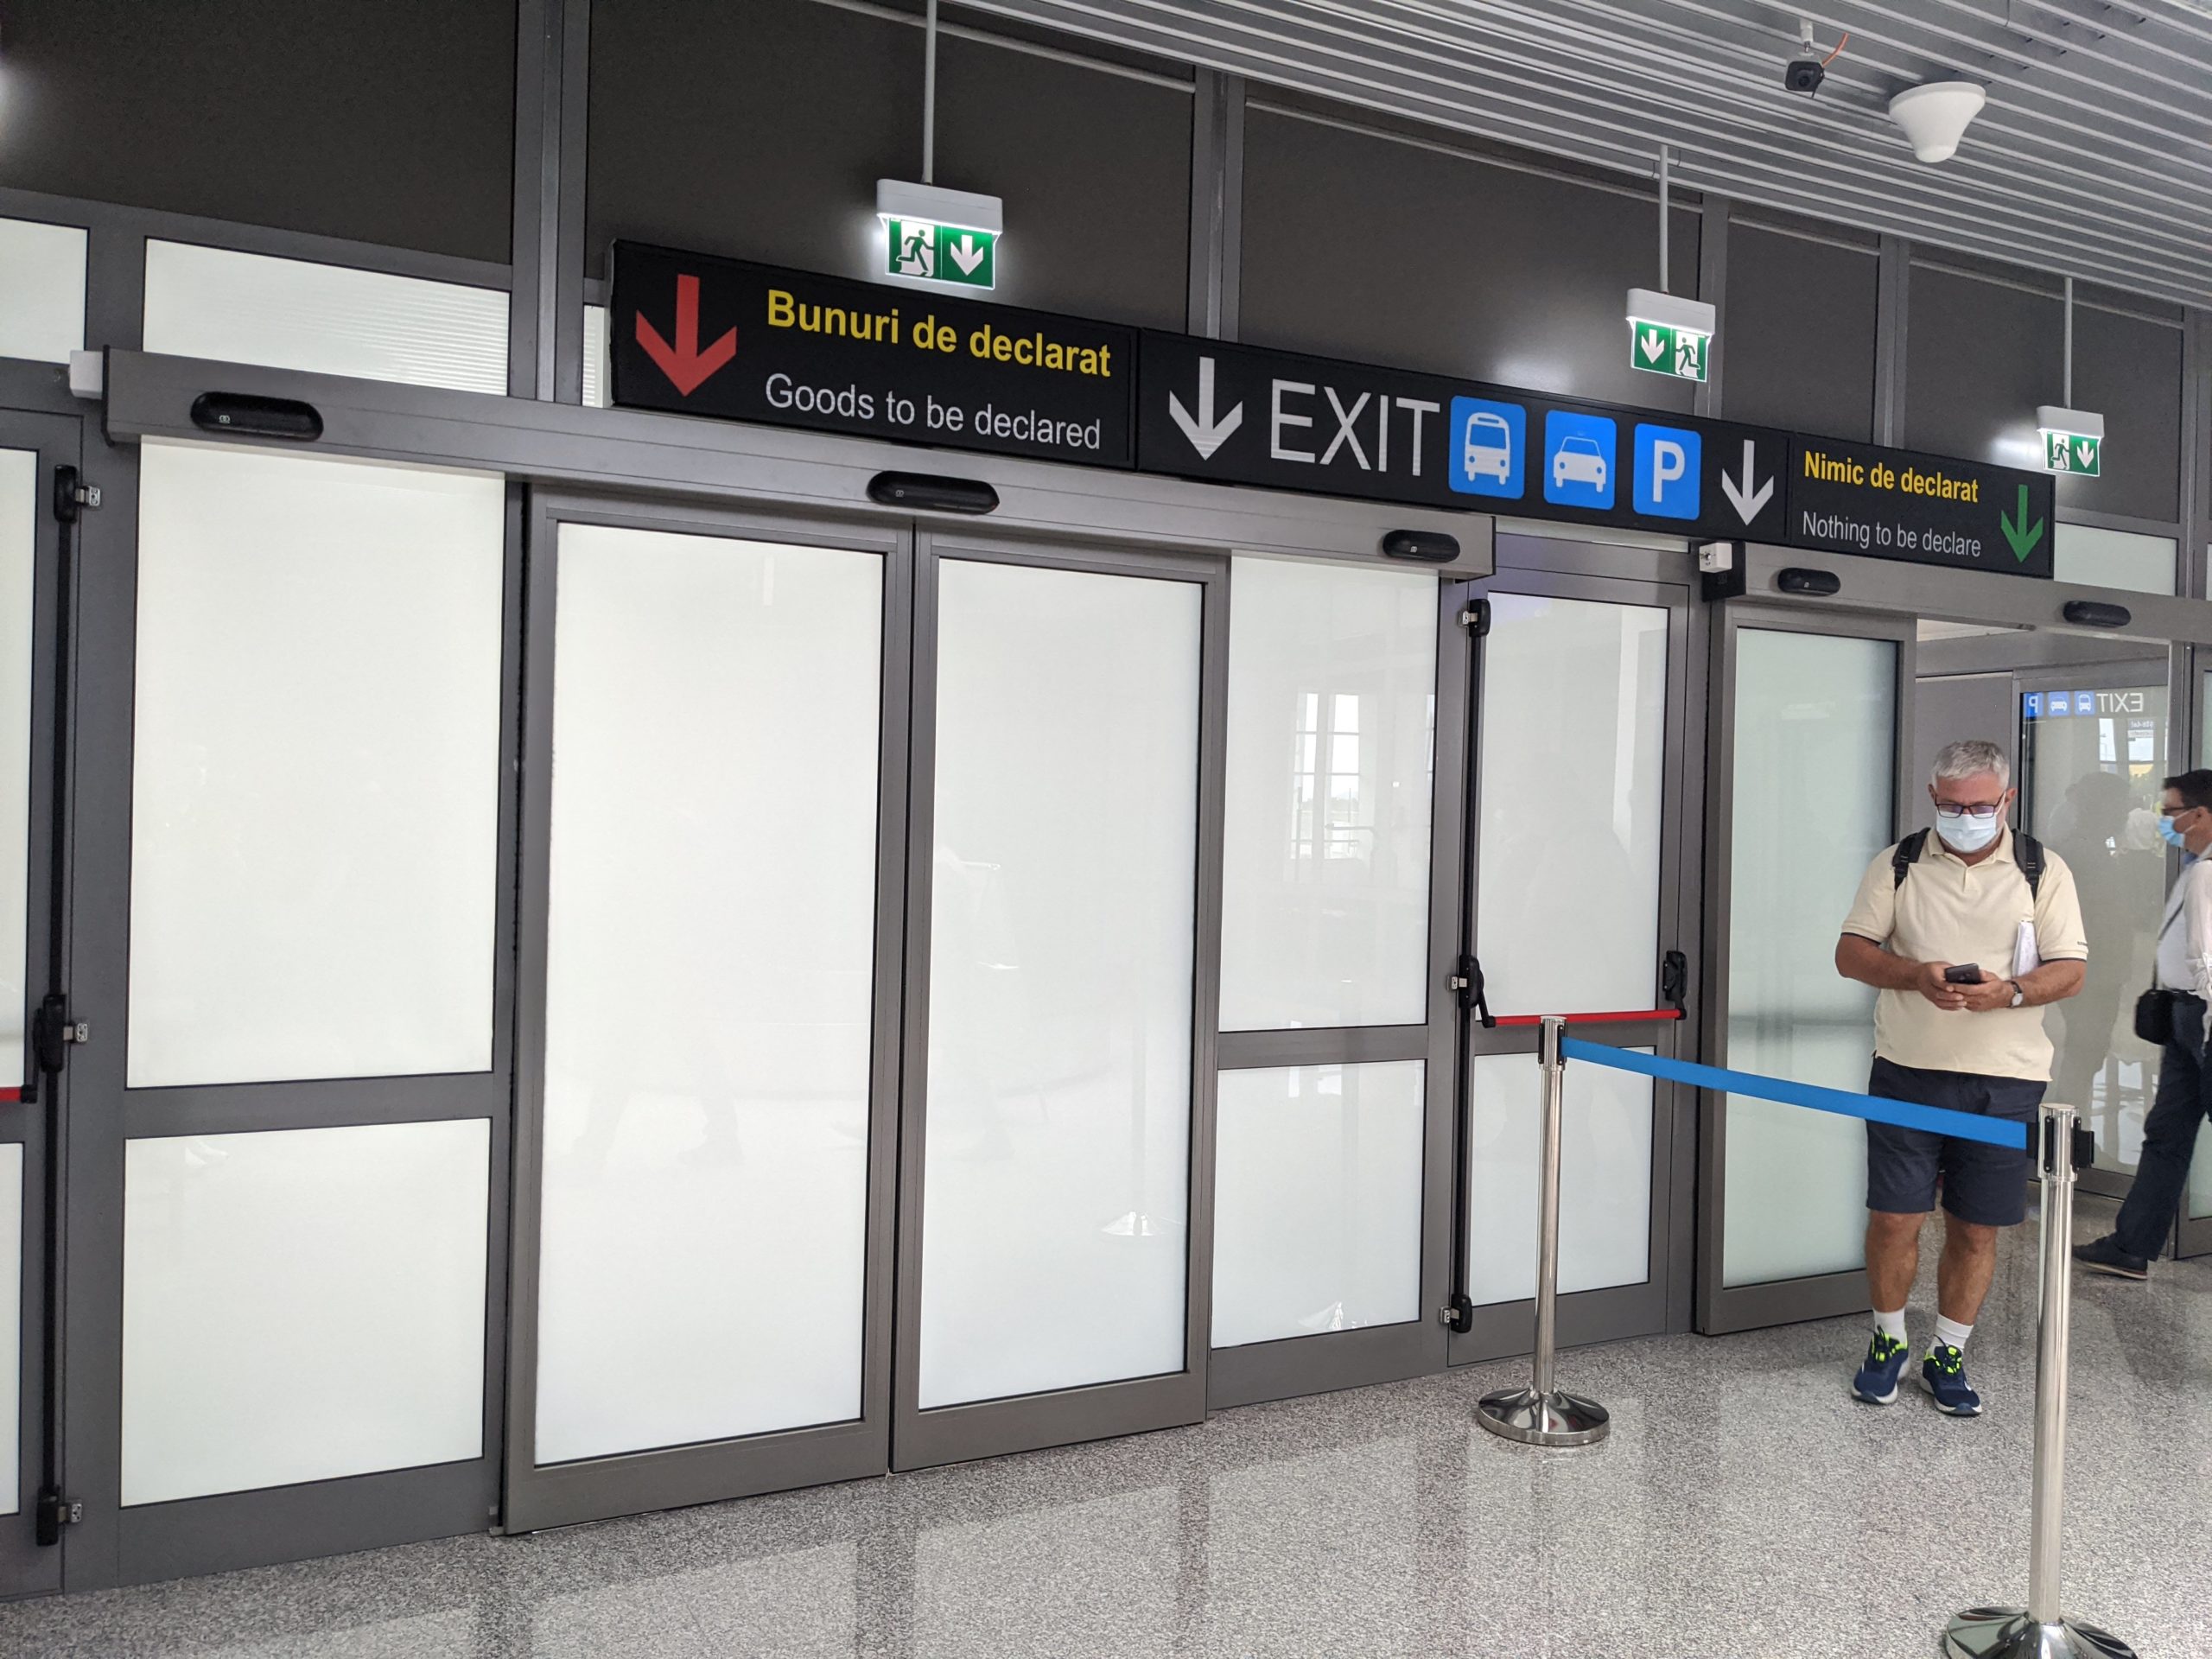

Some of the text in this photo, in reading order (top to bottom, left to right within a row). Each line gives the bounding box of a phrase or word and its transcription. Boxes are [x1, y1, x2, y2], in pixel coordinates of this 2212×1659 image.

[768, 289, 1111, 378] Bunuri de declarat
[766, 373, 1101, 449] Goods to be declared
[1270, 378, 1686, 503] EXIT P
[1804, 449, 1979, 503] Nimic de declarat
[1802, 511, 1982, 557] Nothing to be declare
